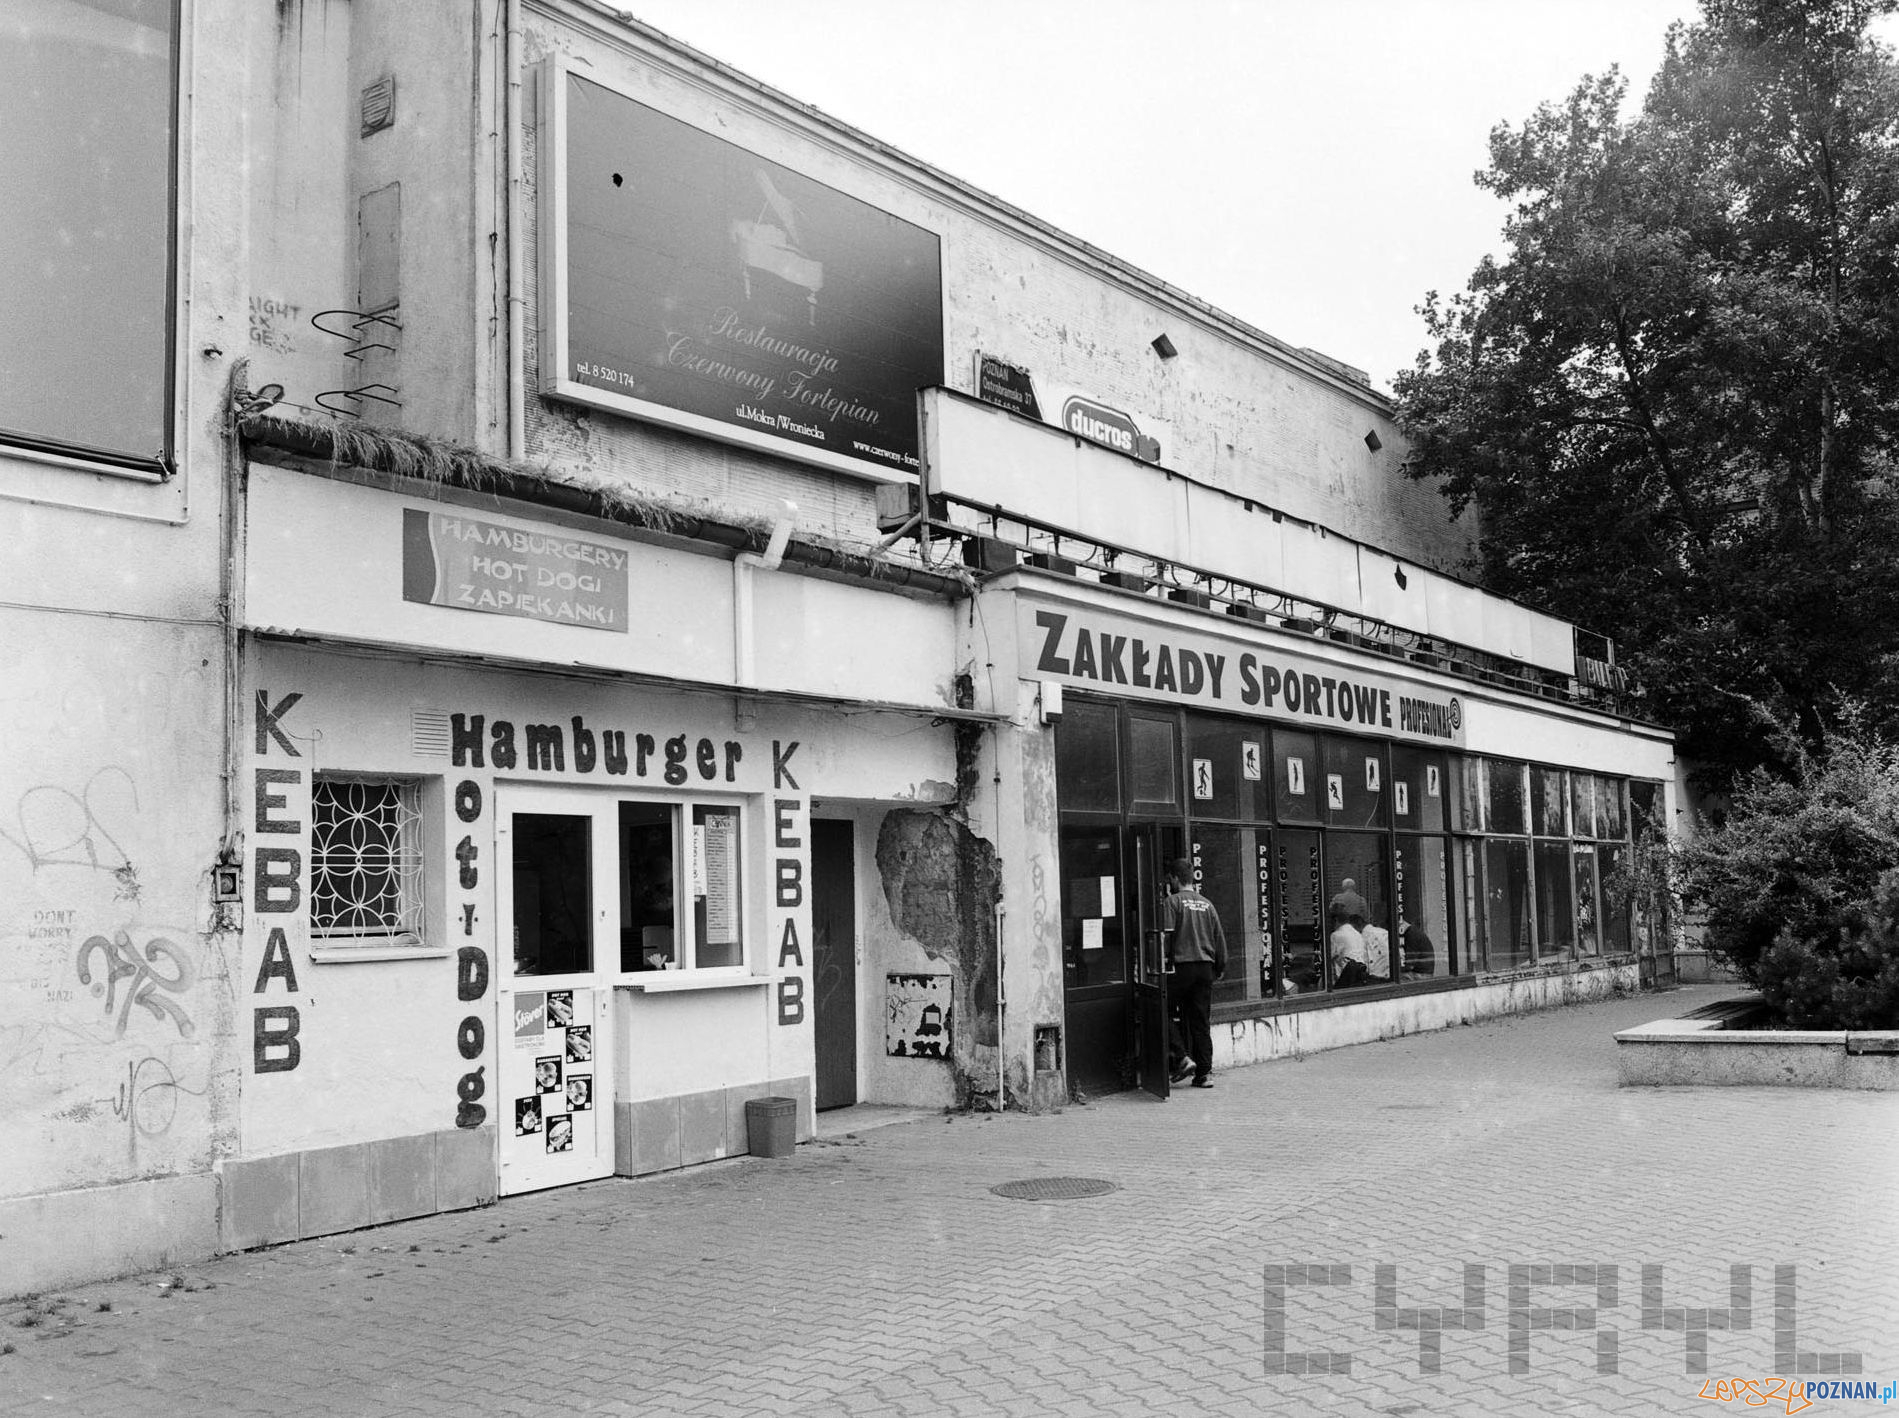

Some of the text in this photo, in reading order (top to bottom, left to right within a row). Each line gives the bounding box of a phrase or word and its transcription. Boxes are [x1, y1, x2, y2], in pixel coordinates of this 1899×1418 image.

[576, 361, 635, 388] tel. 8 520 174
[661, 323, 880, 426] Czerwony Fortepian
[709, 306, 840, 376] Restauracja
[1070, 408, 1132, 451] ducros
[440, 516, 625, 571] HAMBURGERY
[472, 554, 602, 594] HOT DOGI
[457, 583, 614, 625] ZAPIEKANKI
[1036, 610, 1393, 729] ZAKŁADY SPORTOWE
[450, 713, 743, 786] Hamburger
[253, 688, 304, 1075] KEBAB
[771, 739, 805, 1026] KEBAB
